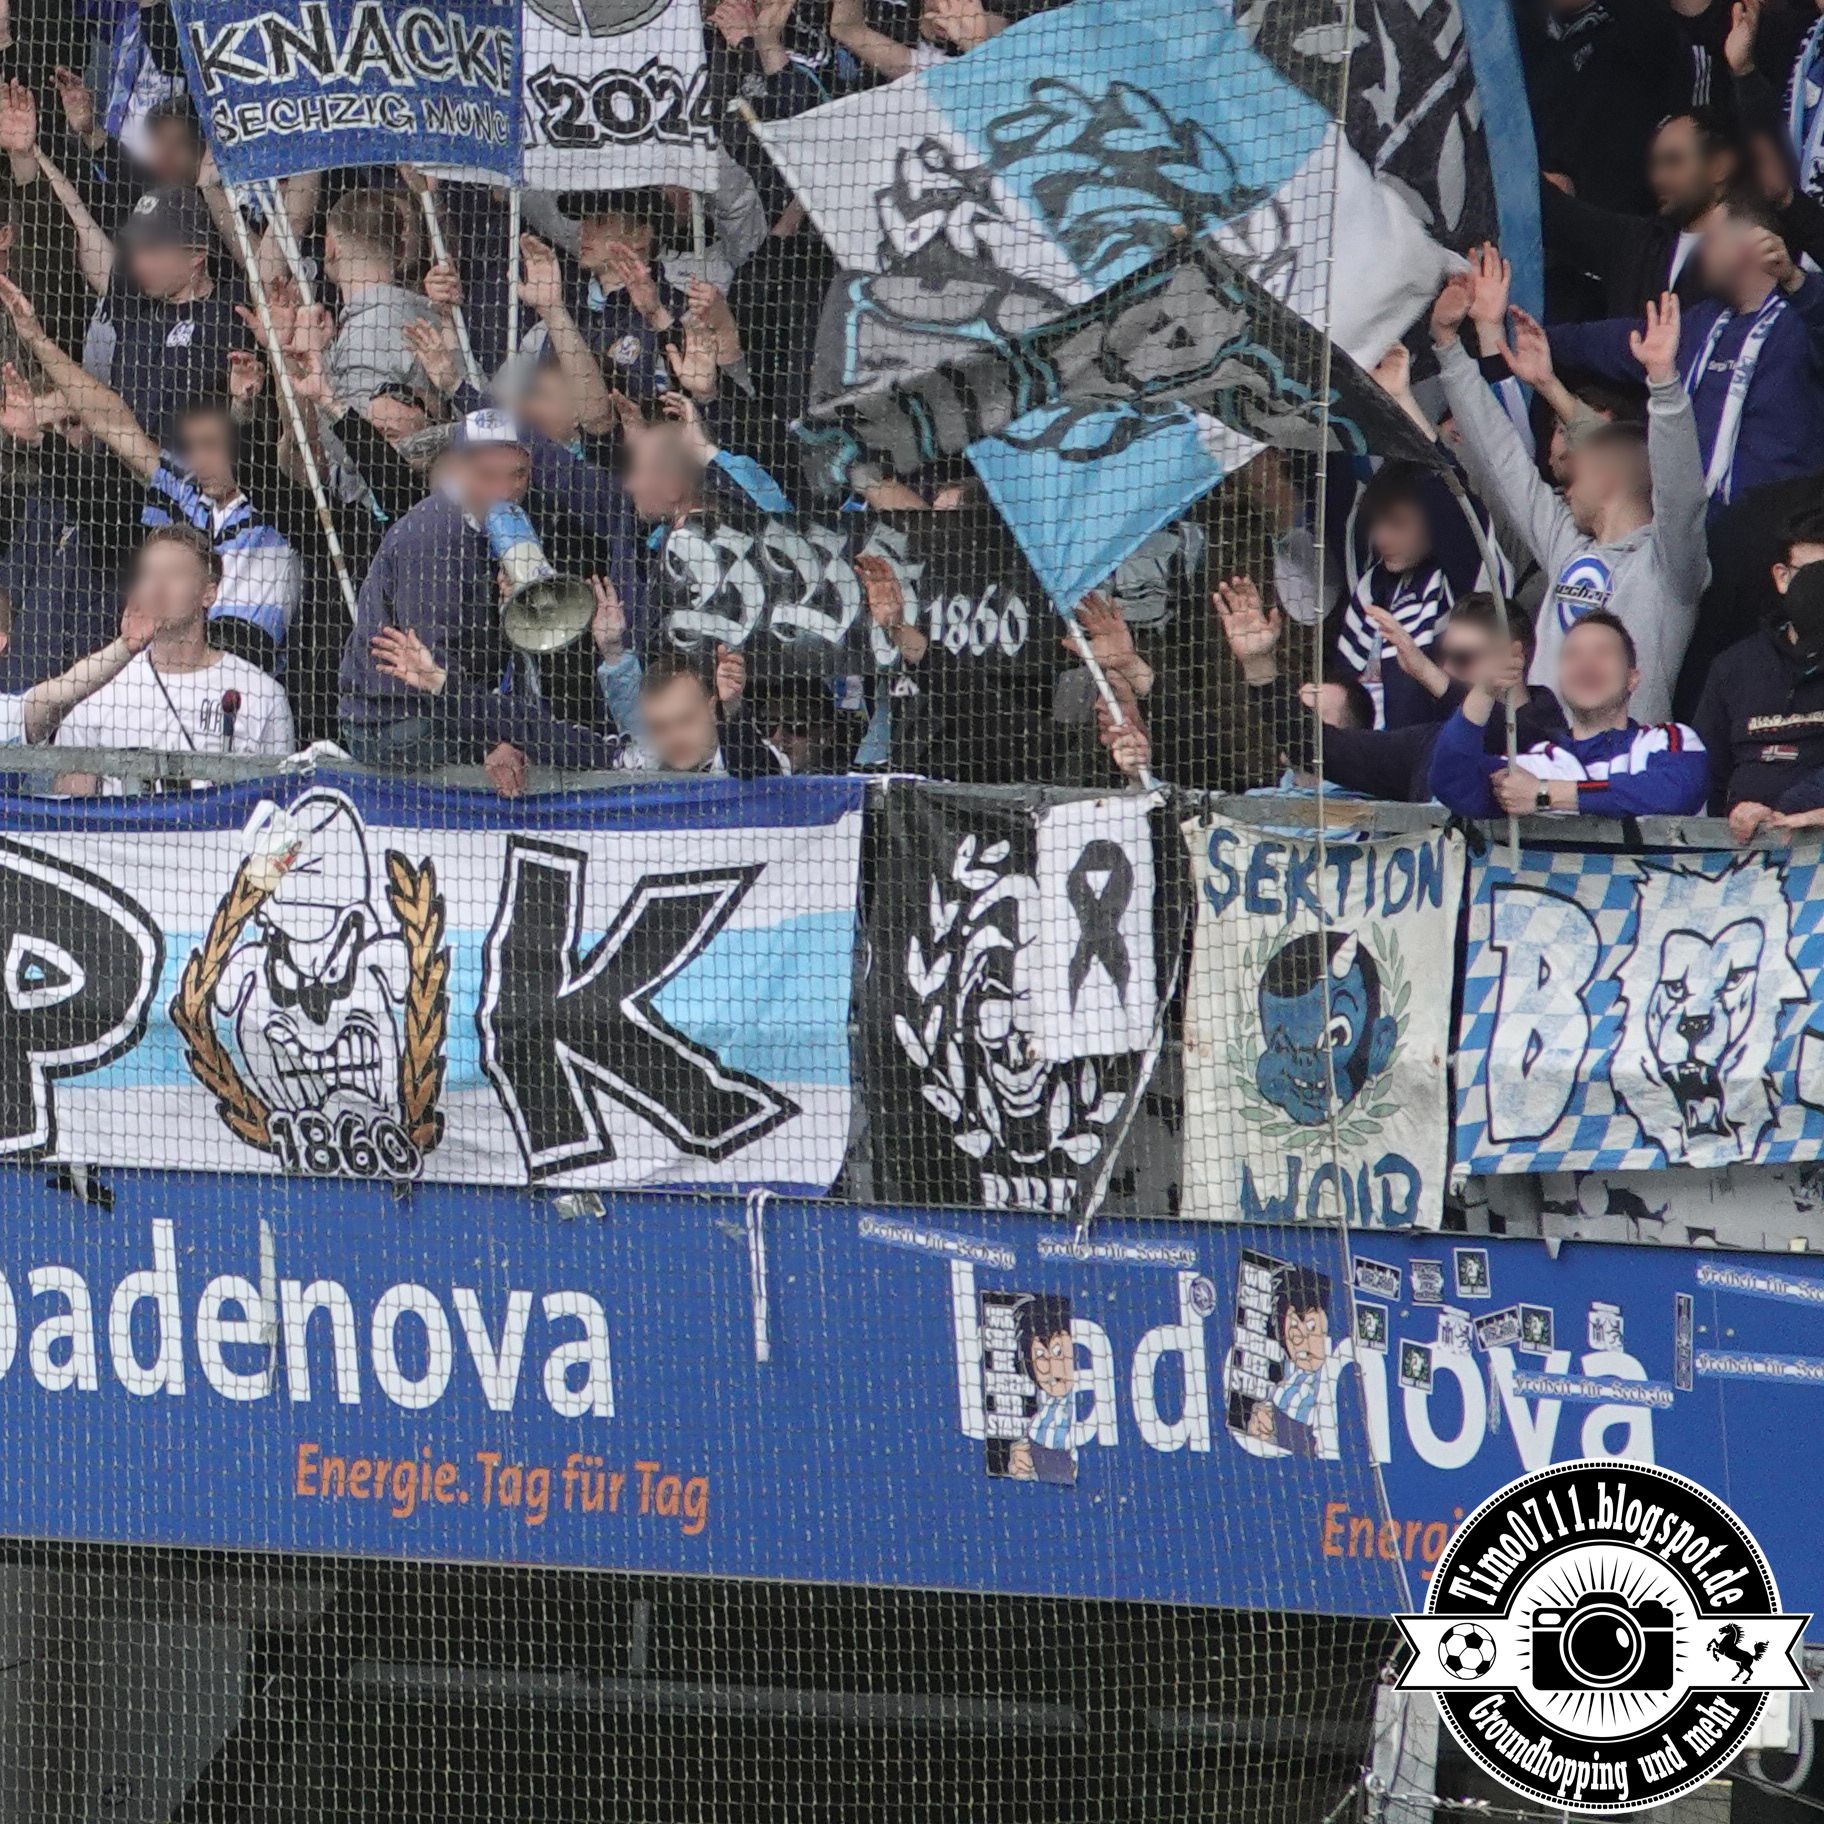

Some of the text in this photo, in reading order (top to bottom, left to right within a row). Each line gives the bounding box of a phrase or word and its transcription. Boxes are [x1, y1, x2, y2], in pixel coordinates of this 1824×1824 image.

[214, 93, 414, 145] SECHZIG
[925, 585, 1028, 657] 1860
[1204, 828, 1445, 929] SEKTION
[477, 835, 801, 1173] K
[270, 1107, 422, 1176] 1860
[476, 1452, 550, 1526] Tag
[561, 1453, 626, 1514] für
[634, 1460, 709, 1536] Tag
